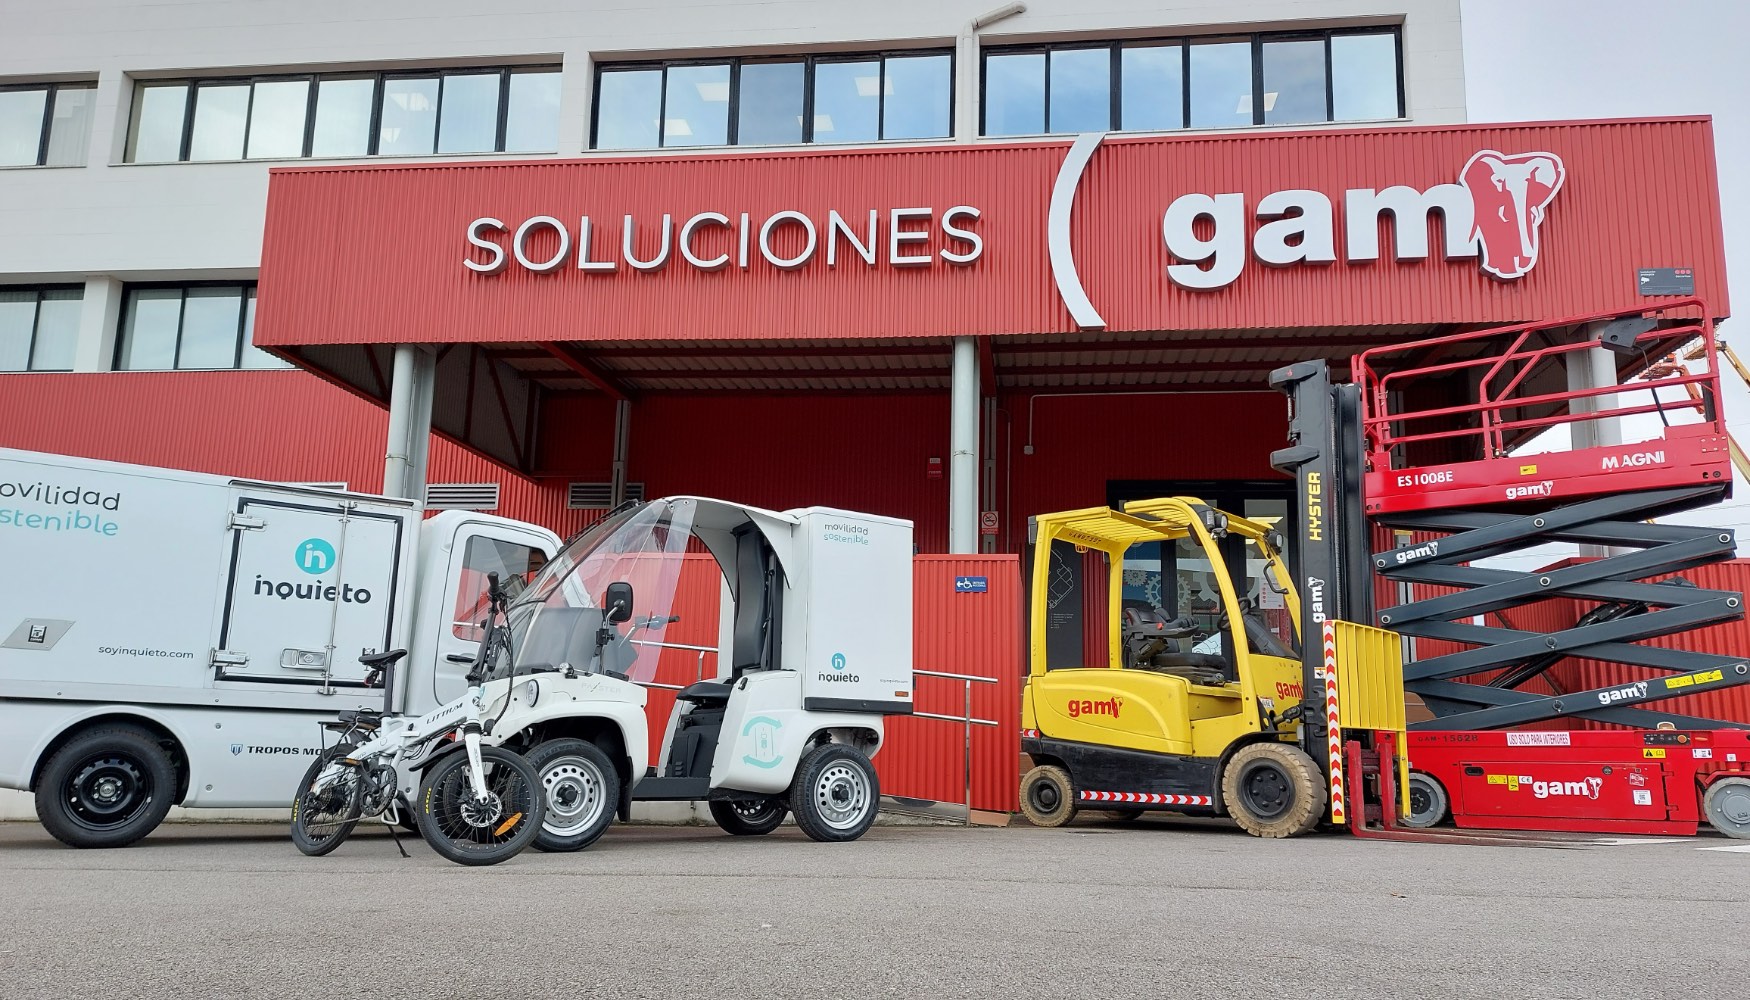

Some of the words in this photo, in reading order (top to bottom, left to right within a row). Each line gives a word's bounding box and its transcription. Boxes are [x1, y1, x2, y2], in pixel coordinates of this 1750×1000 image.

[463, 205, 983, 276] SOLUCIONES
[1163, 183, 1479, 291] gam
[1602, 451, 1666, 470] MAGNI
[1506, 485, 1544, 500] gam
[1308, 472, 1322, 541] HYSTER
[825, 523, 869, 535] movilidad
[824, 533, 869, 545] sostenible
[1396, 546, 1431, 564] gam
[254, 574, 372, 604] inquieto
[1312, 586, 1326, 623] gam
[98, 646, 194, 659] soyinquieto.com
[818, 672, 860, 683] inquieto
[1598, 687, 1639, 705] gam
[1068, 699, 1112, 718] gam
[247, 746, 299, 755] TROPOS
[1533, 781, 1588, 799] gam
